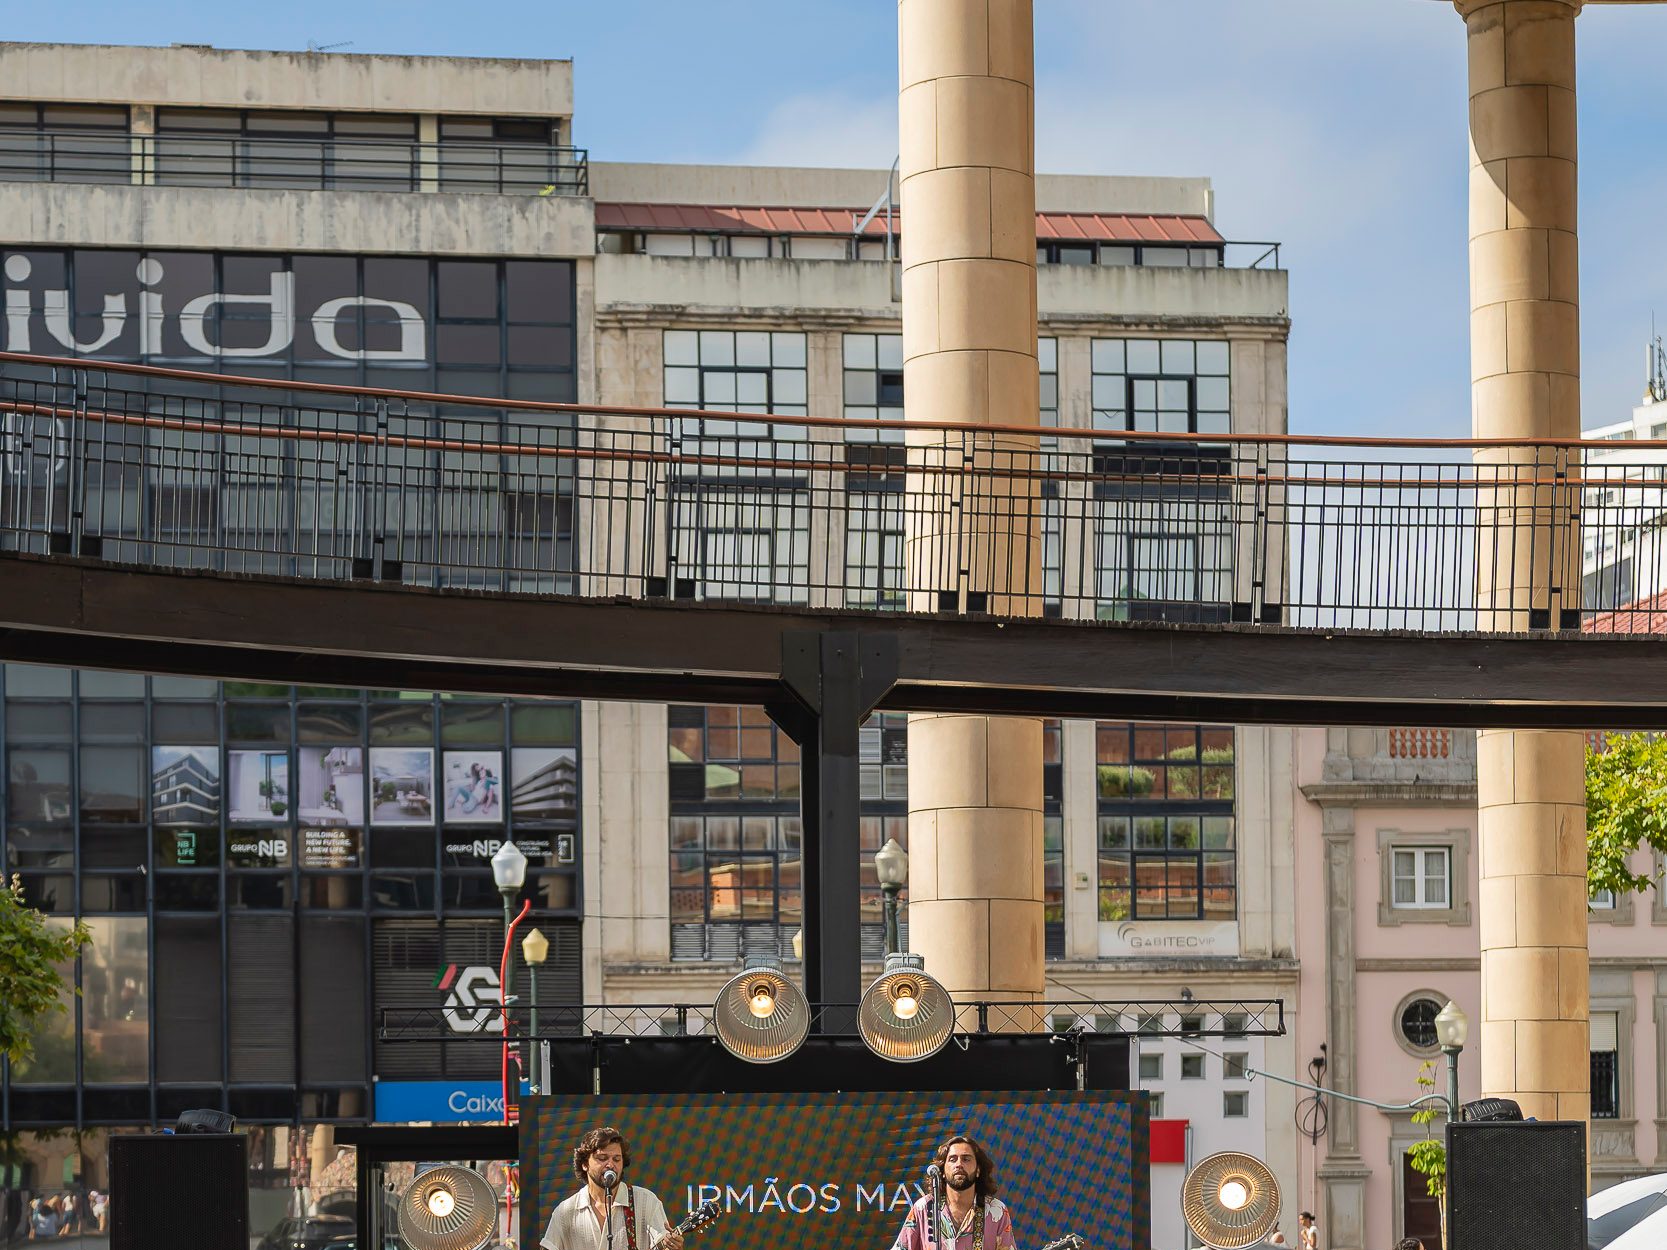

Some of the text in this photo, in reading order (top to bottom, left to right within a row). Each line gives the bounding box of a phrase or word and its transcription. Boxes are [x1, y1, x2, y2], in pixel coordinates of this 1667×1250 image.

[230, 839, 288, 857] GRUPO NB
[687, 1177, 841, 1214] IRMÃOS
